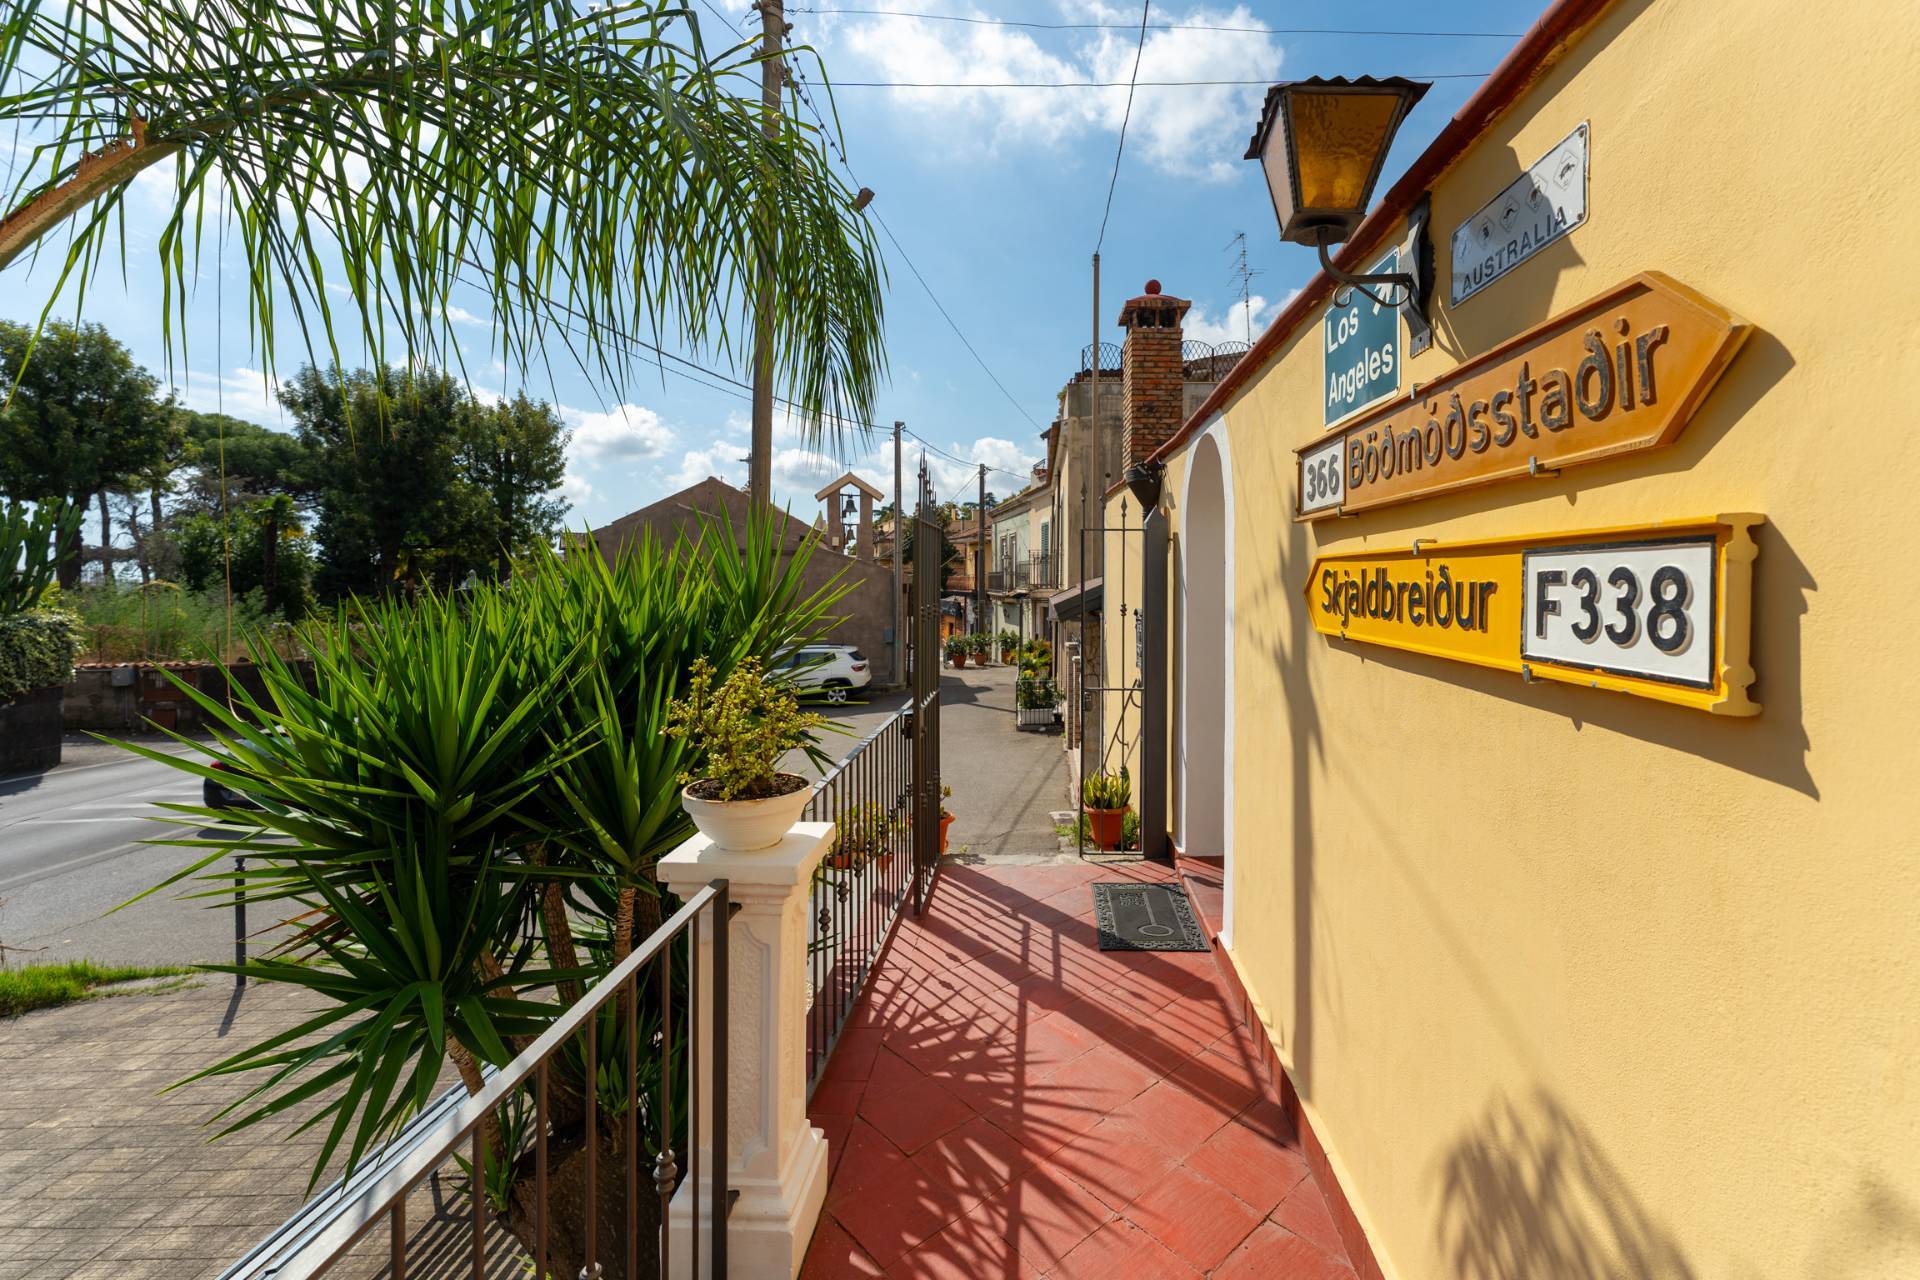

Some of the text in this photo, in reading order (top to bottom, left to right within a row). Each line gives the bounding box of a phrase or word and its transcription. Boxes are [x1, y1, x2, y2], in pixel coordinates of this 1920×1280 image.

[1462, 206, 1568, 293] AUSTRALIA
[1327, 307, 1359, 354] Los
[1306, 317, 1670, 503] 366 Böðmóðsstaðir
[1328, 343, 1394, 407] Angeles
[1321, 564, 1694, 656] Skjaldbreiður F338
